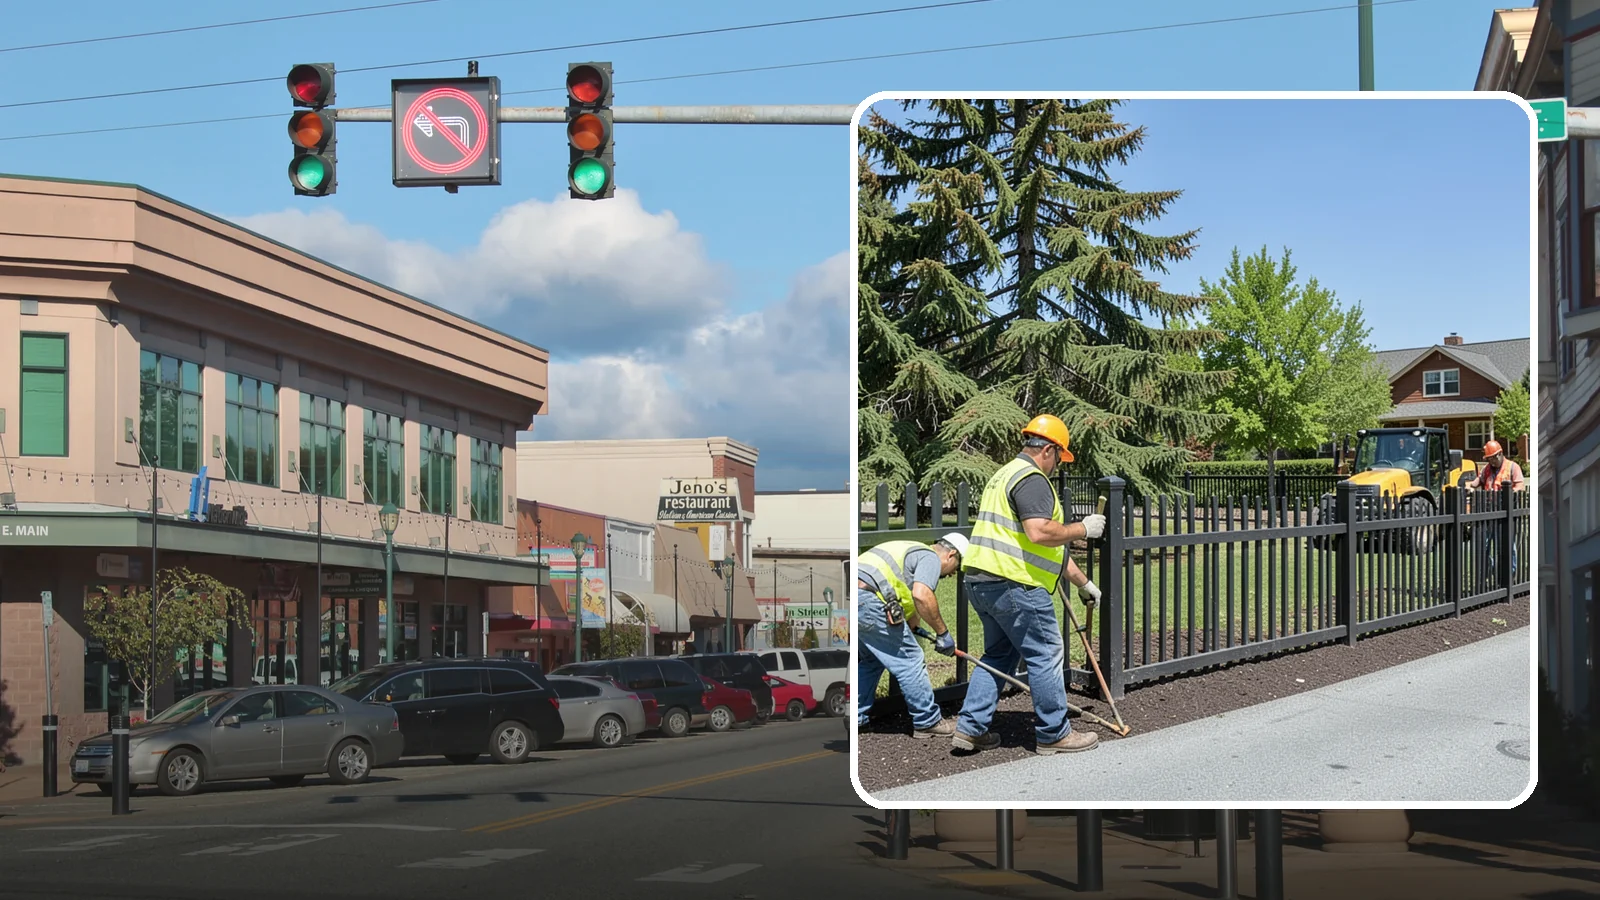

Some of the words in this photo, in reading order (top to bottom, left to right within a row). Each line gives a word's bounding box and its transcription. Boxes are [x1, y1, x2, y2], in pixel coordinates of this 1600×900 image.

[669, 479, 728, 495] Jeno's
[664, 496, 731, 509] restaurant
[658, 509, 682, 520] Italian
[685, 509, 715, 520] American
[714, 509, 738, 519] Cuisine
[2, 525, 13, 536] E.
[15, 525, 49, 536] MAIN
[797, 607, 828, 617] Street
